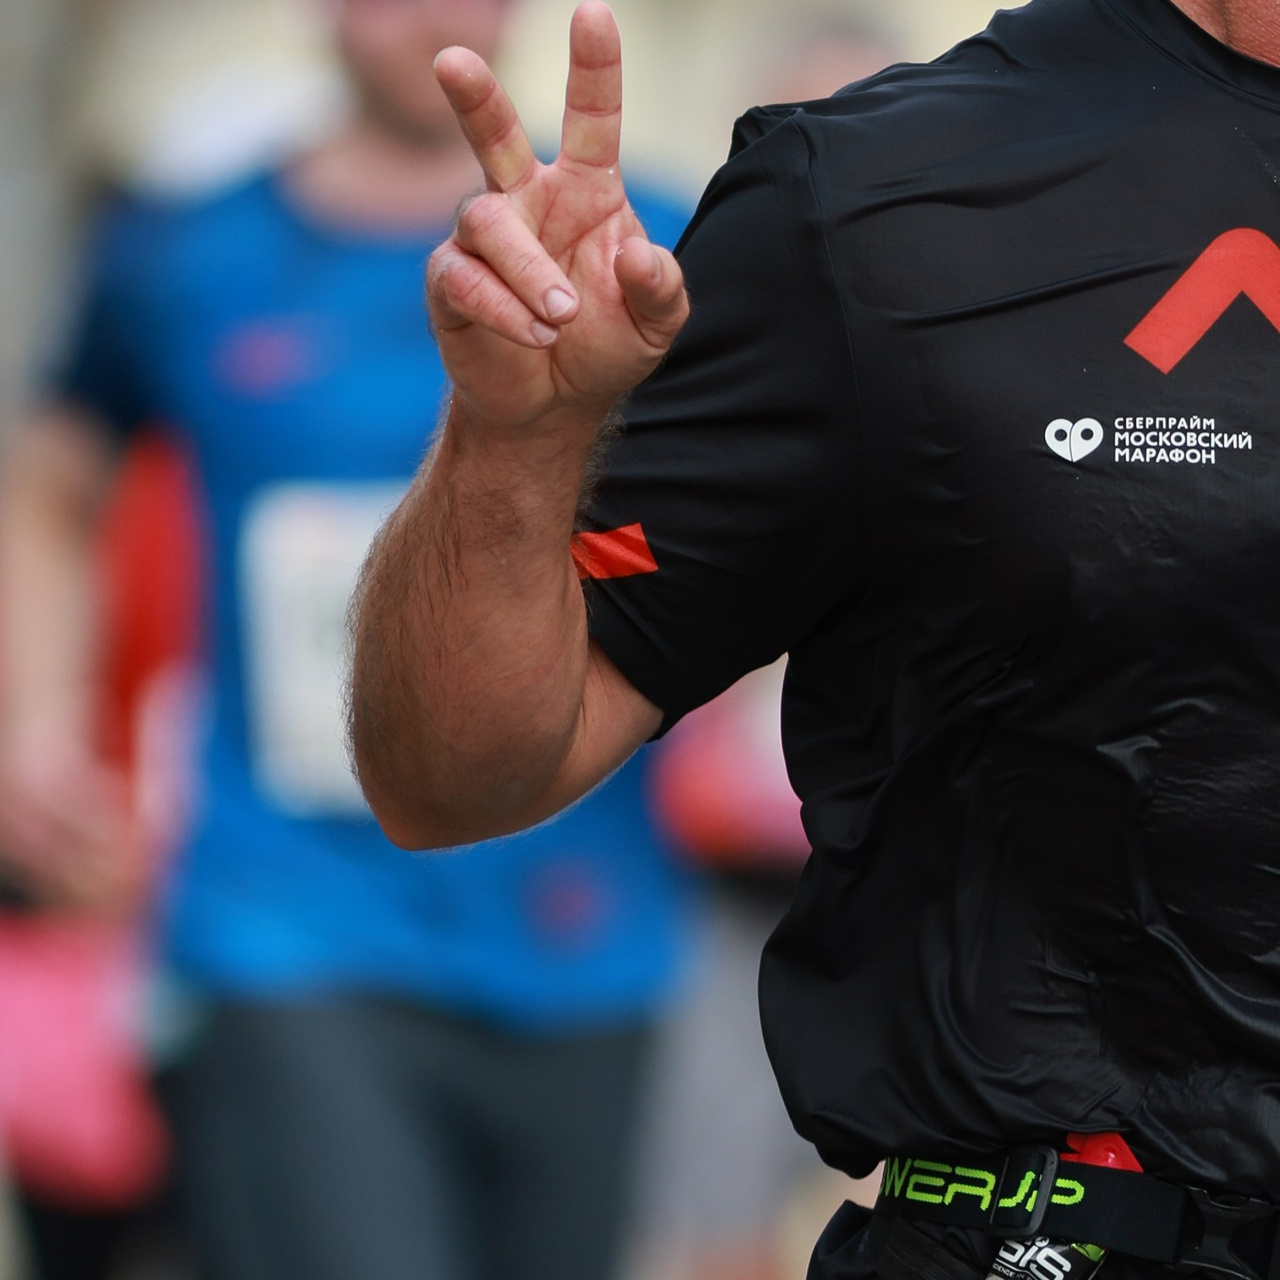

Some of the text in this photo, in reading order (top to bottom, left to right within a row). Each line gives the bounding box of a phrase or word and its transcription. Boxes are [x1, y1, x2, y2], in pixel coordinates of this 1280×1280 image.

[1114, 415, 1215, 430] СБЕРПРАЙМ
[1114, 431, 1252, 450] МОСКОВСКИЙ
[1114, 448, 1215, 464] МАРАФОН
